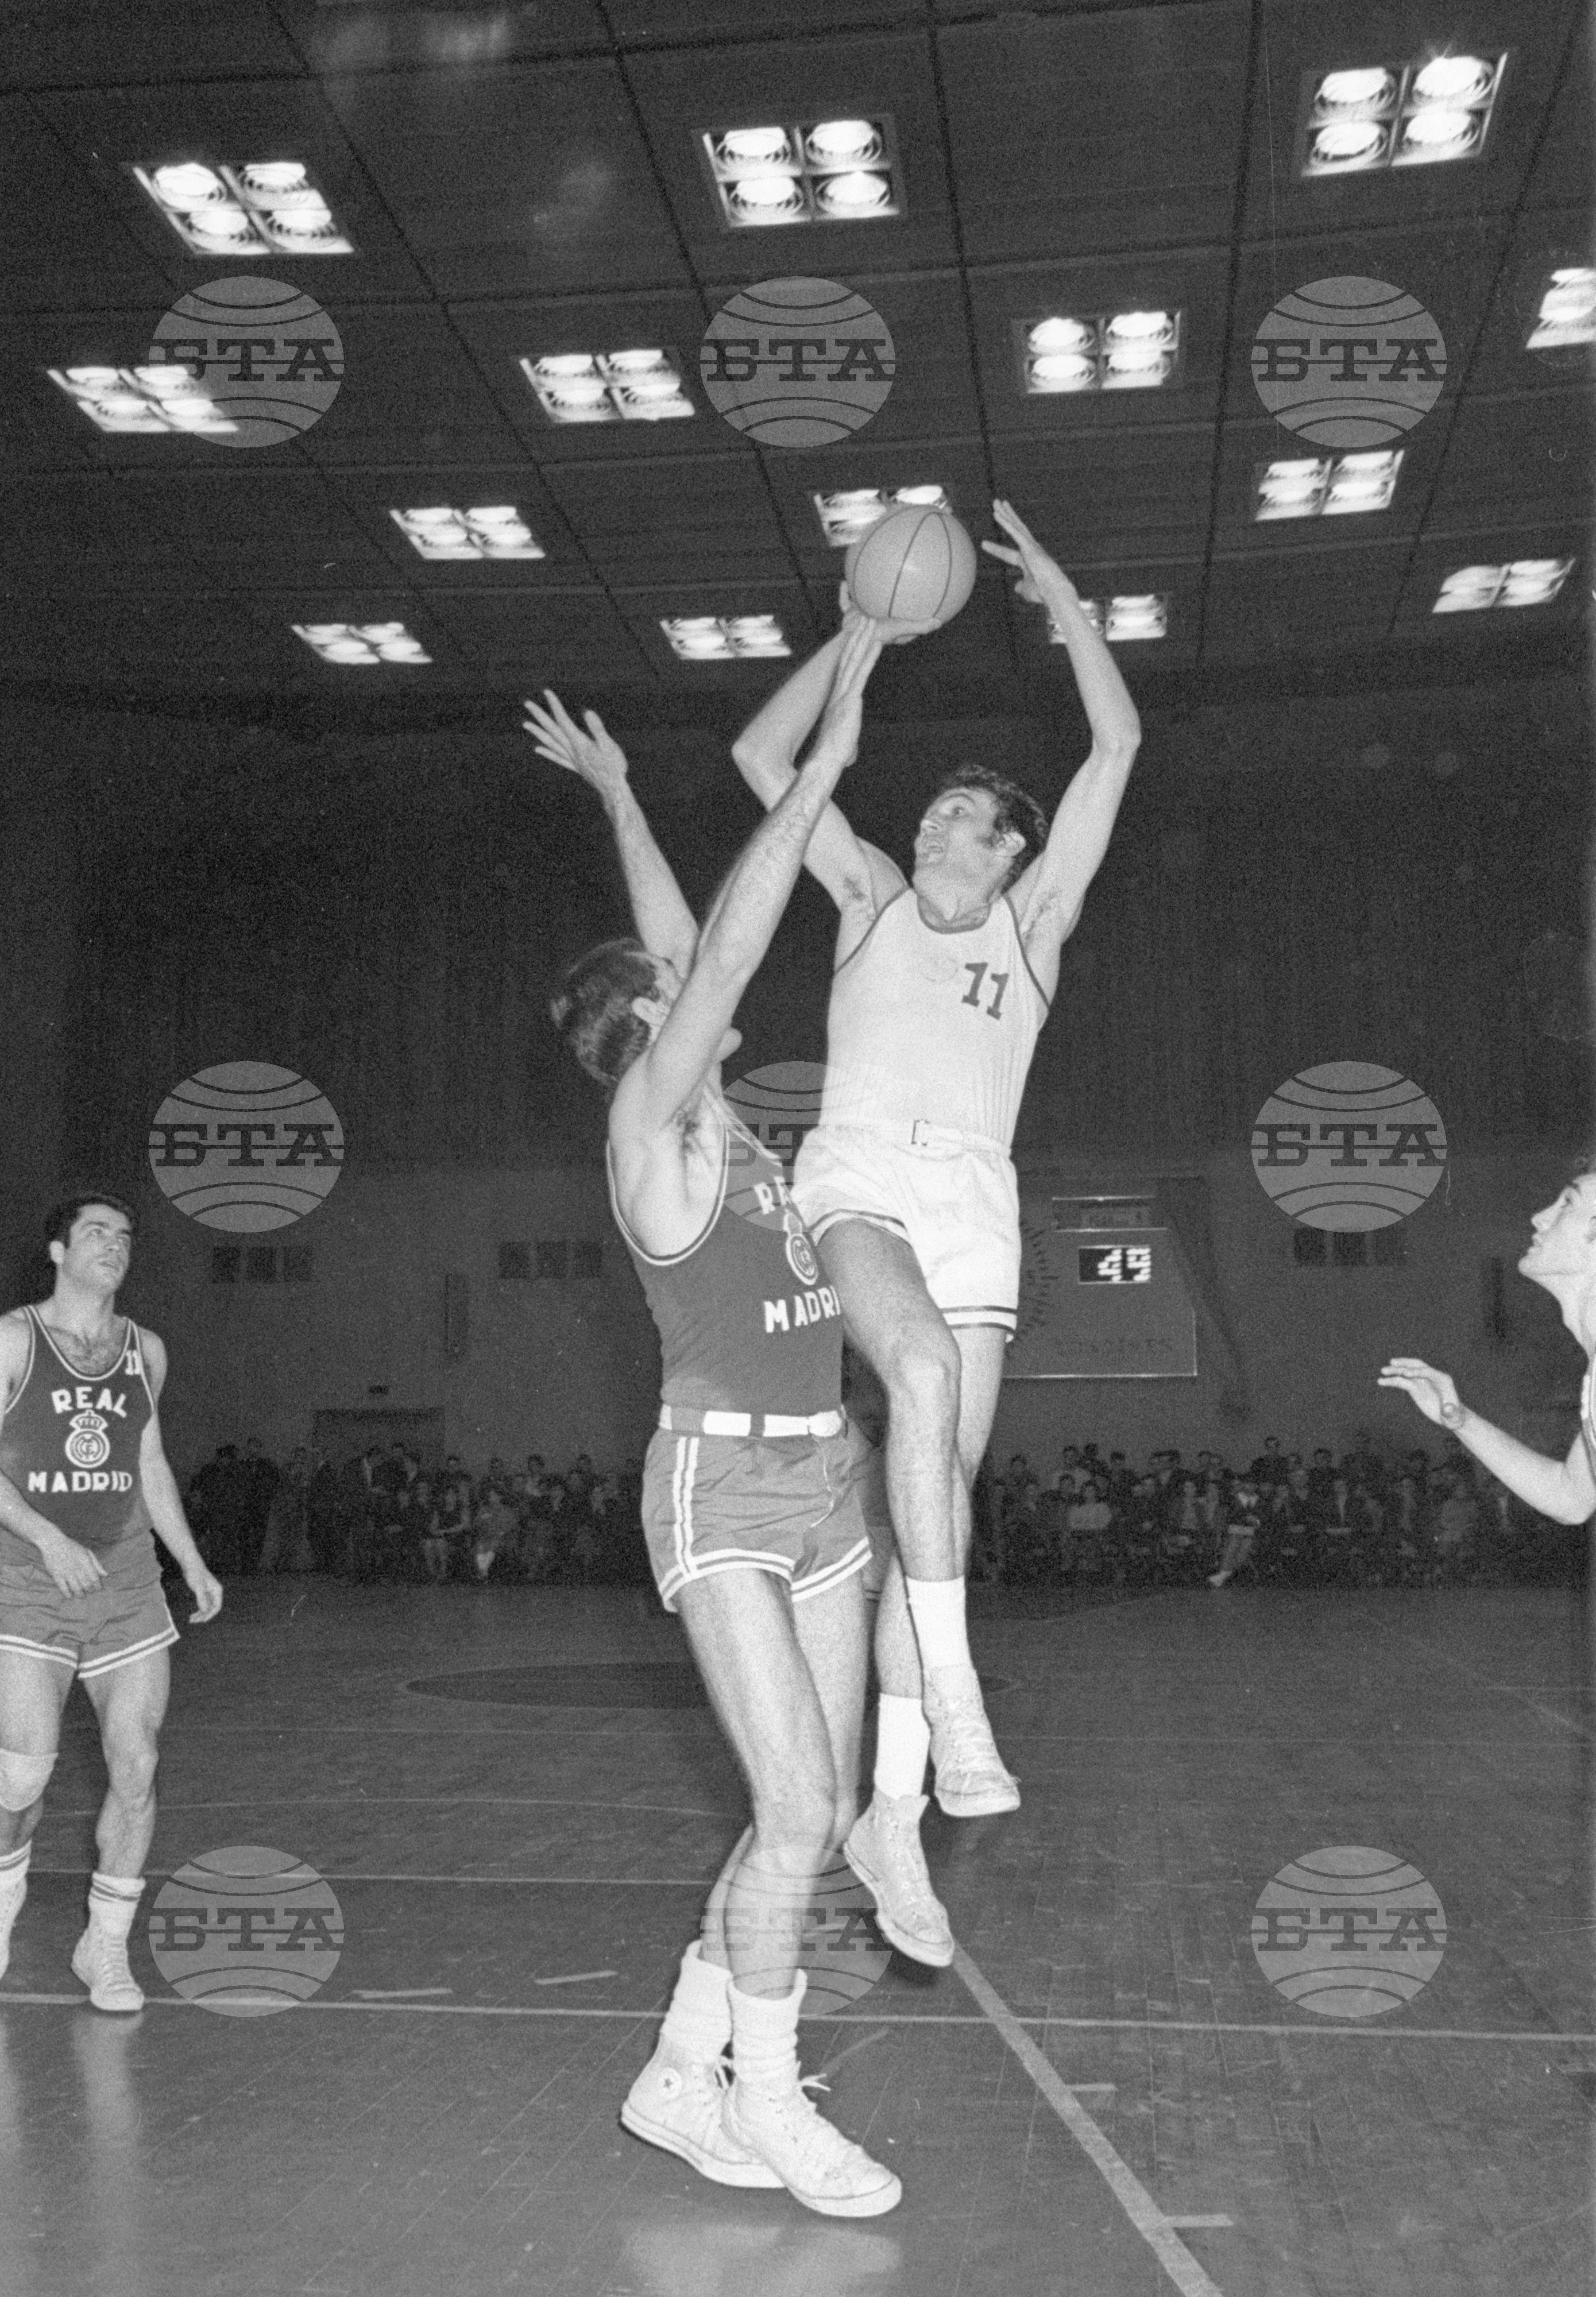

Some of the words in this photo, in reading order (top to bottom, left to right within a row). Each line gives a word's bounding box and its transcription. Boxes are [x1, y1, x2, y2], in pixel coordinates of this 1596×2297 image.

[961, 961, 1010, 1021] 11
[1098, 1248, 1151, 1281] 49
[125, 1349, 142, 1375] 11
[51, 1386, 127, 1418] REAL
[28, 1471, 133, 1492] MADRID
